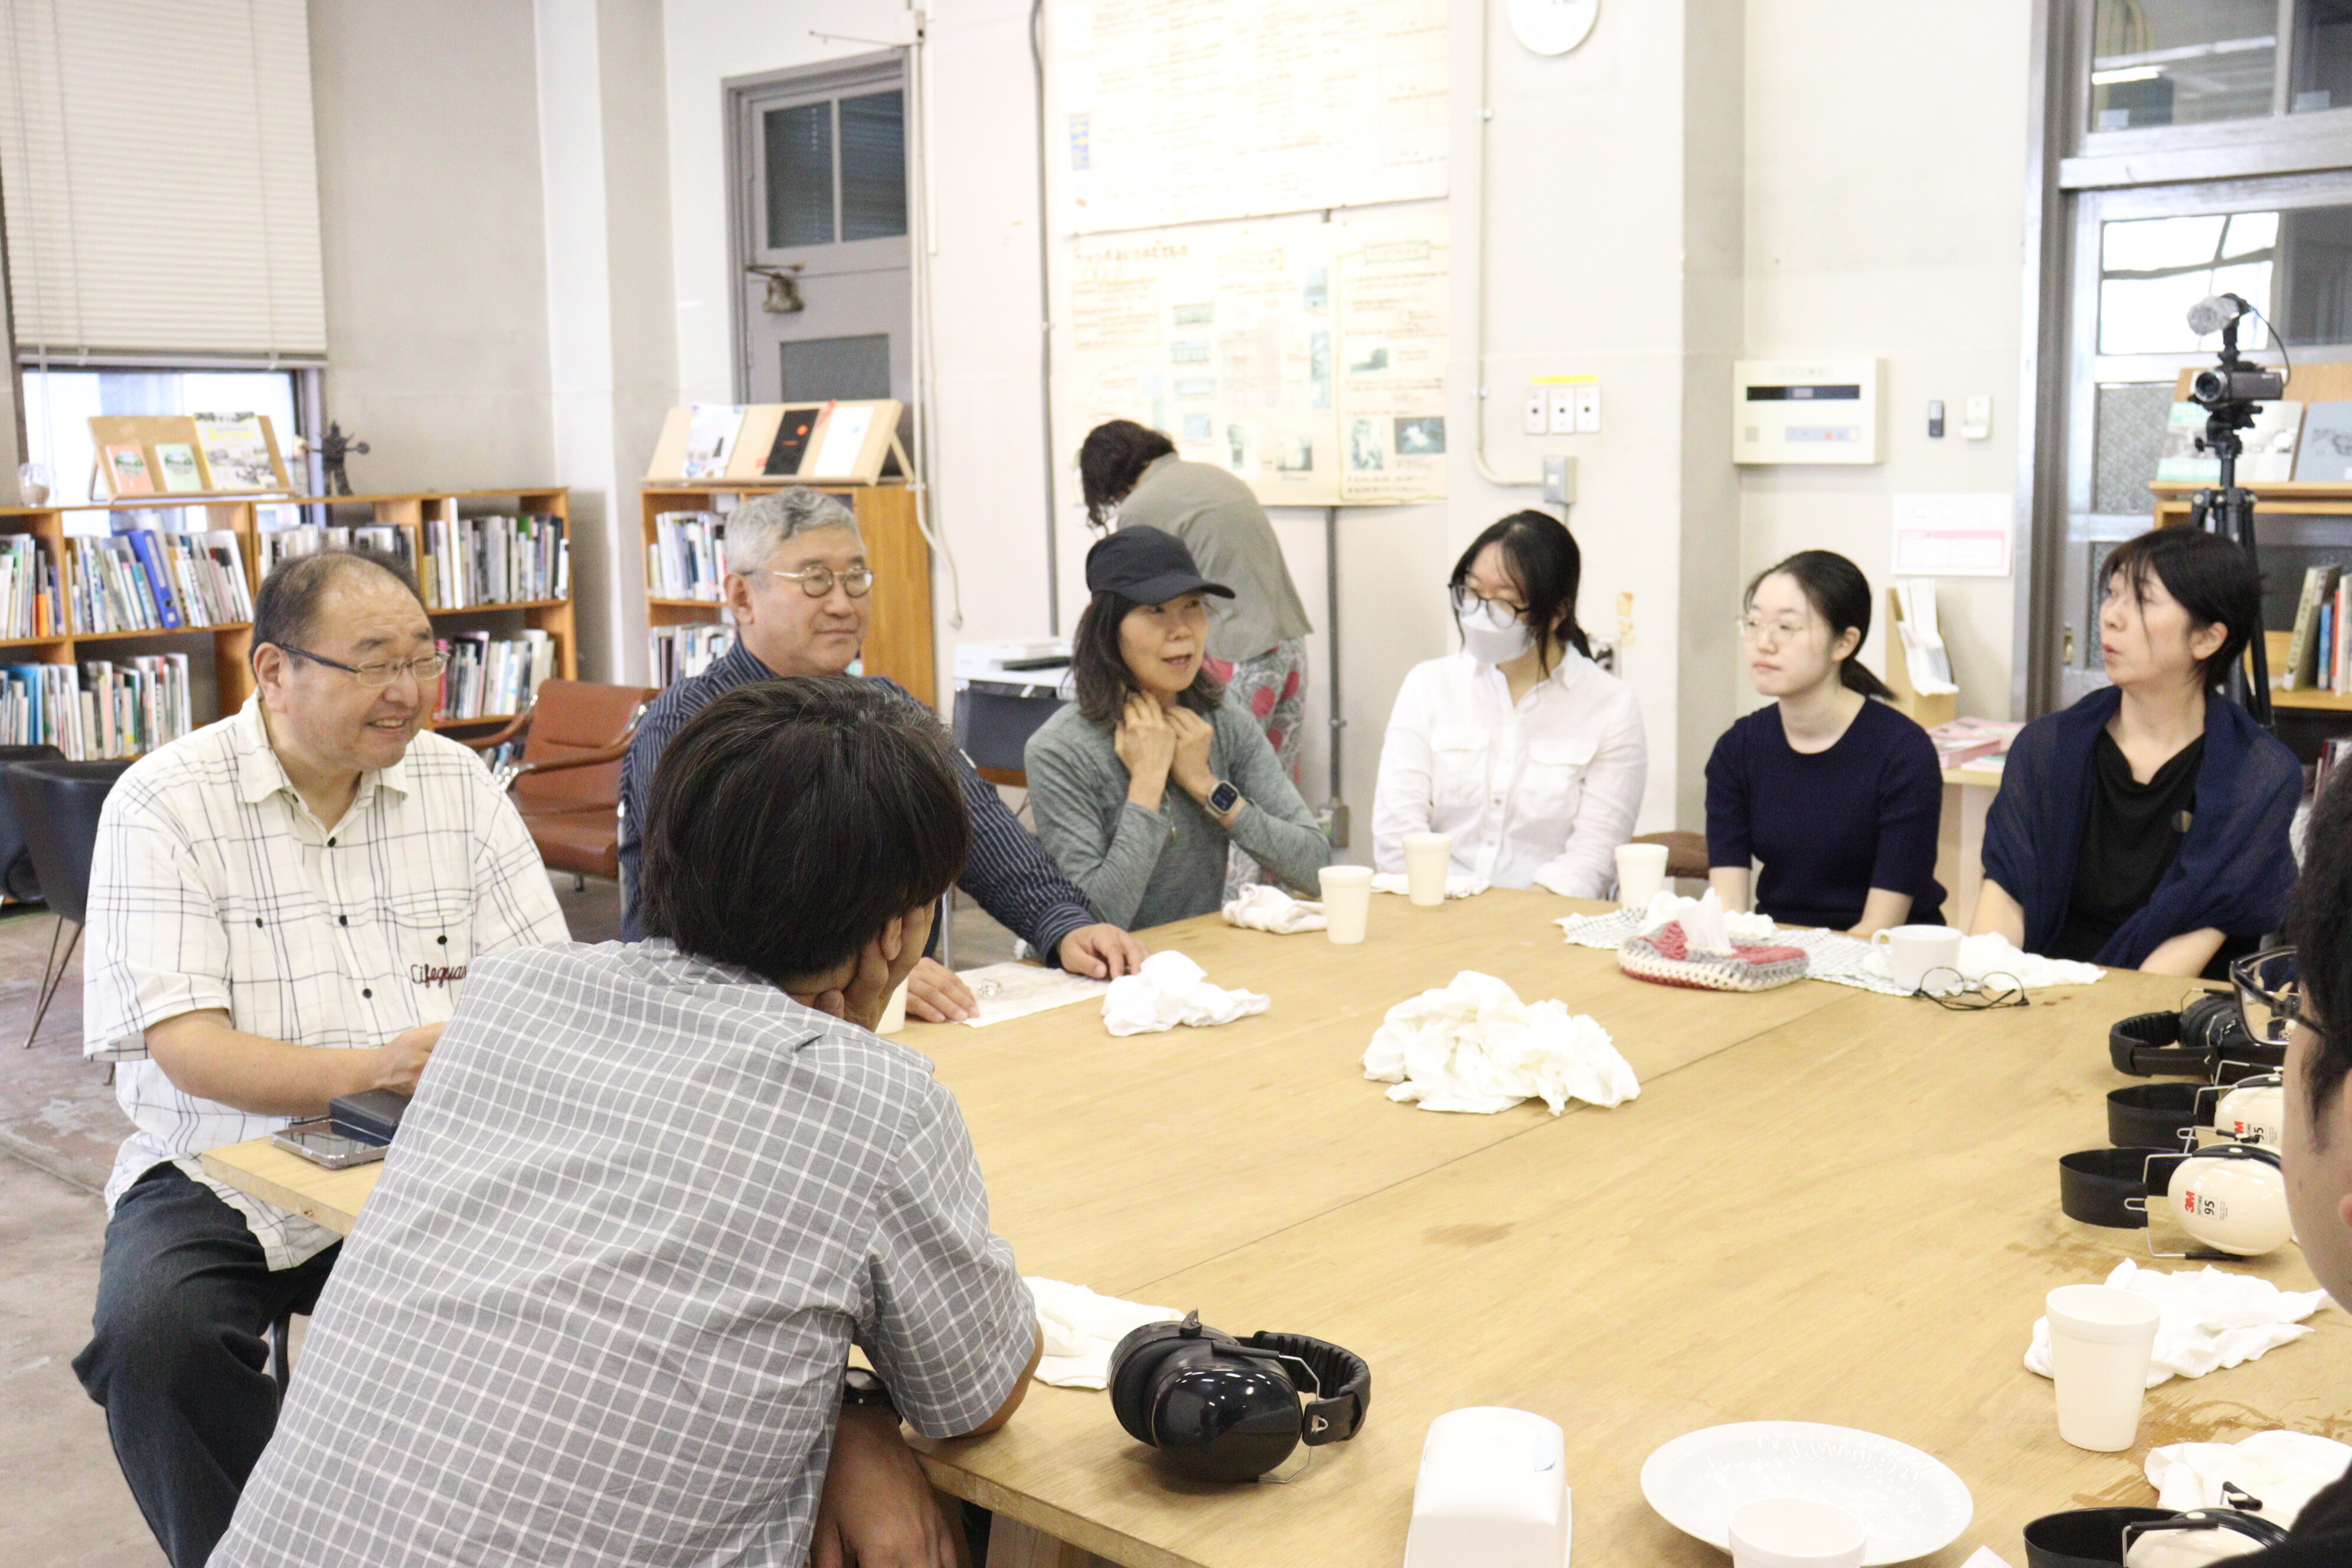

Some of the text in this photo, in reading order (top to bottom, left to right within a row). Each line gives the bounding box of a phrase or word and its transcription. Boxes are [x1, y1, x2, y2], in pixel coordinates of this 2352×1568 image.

[2234, 1121, 2244, 1133] M
[2185, 1190, 2195, 1213] 3M
[2204, 1200, 2215, 1216] 95
